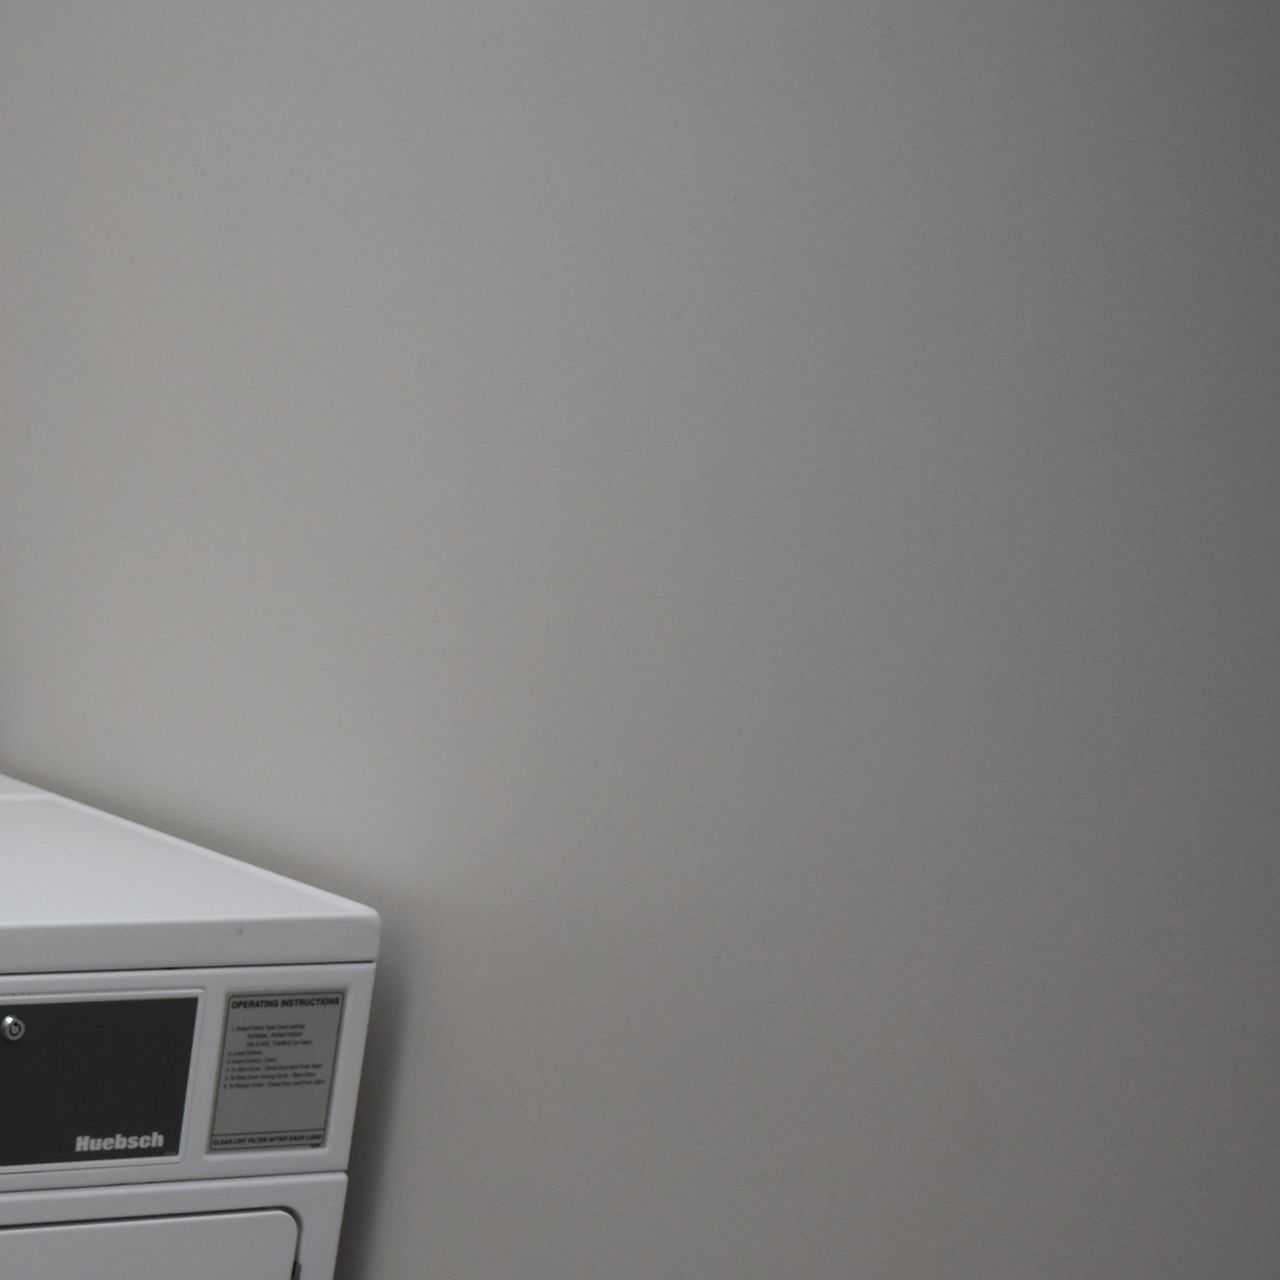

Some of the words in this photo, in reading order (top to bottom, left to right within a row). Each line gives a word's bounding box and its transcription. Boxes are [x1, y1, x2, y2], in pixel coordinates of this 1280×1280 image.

[231, 999, 279, 1009] OPERATING
[280, 997, 339, 1008] INSTRUCTIONS
[75, 1131, 164, 1152] Huebsch
